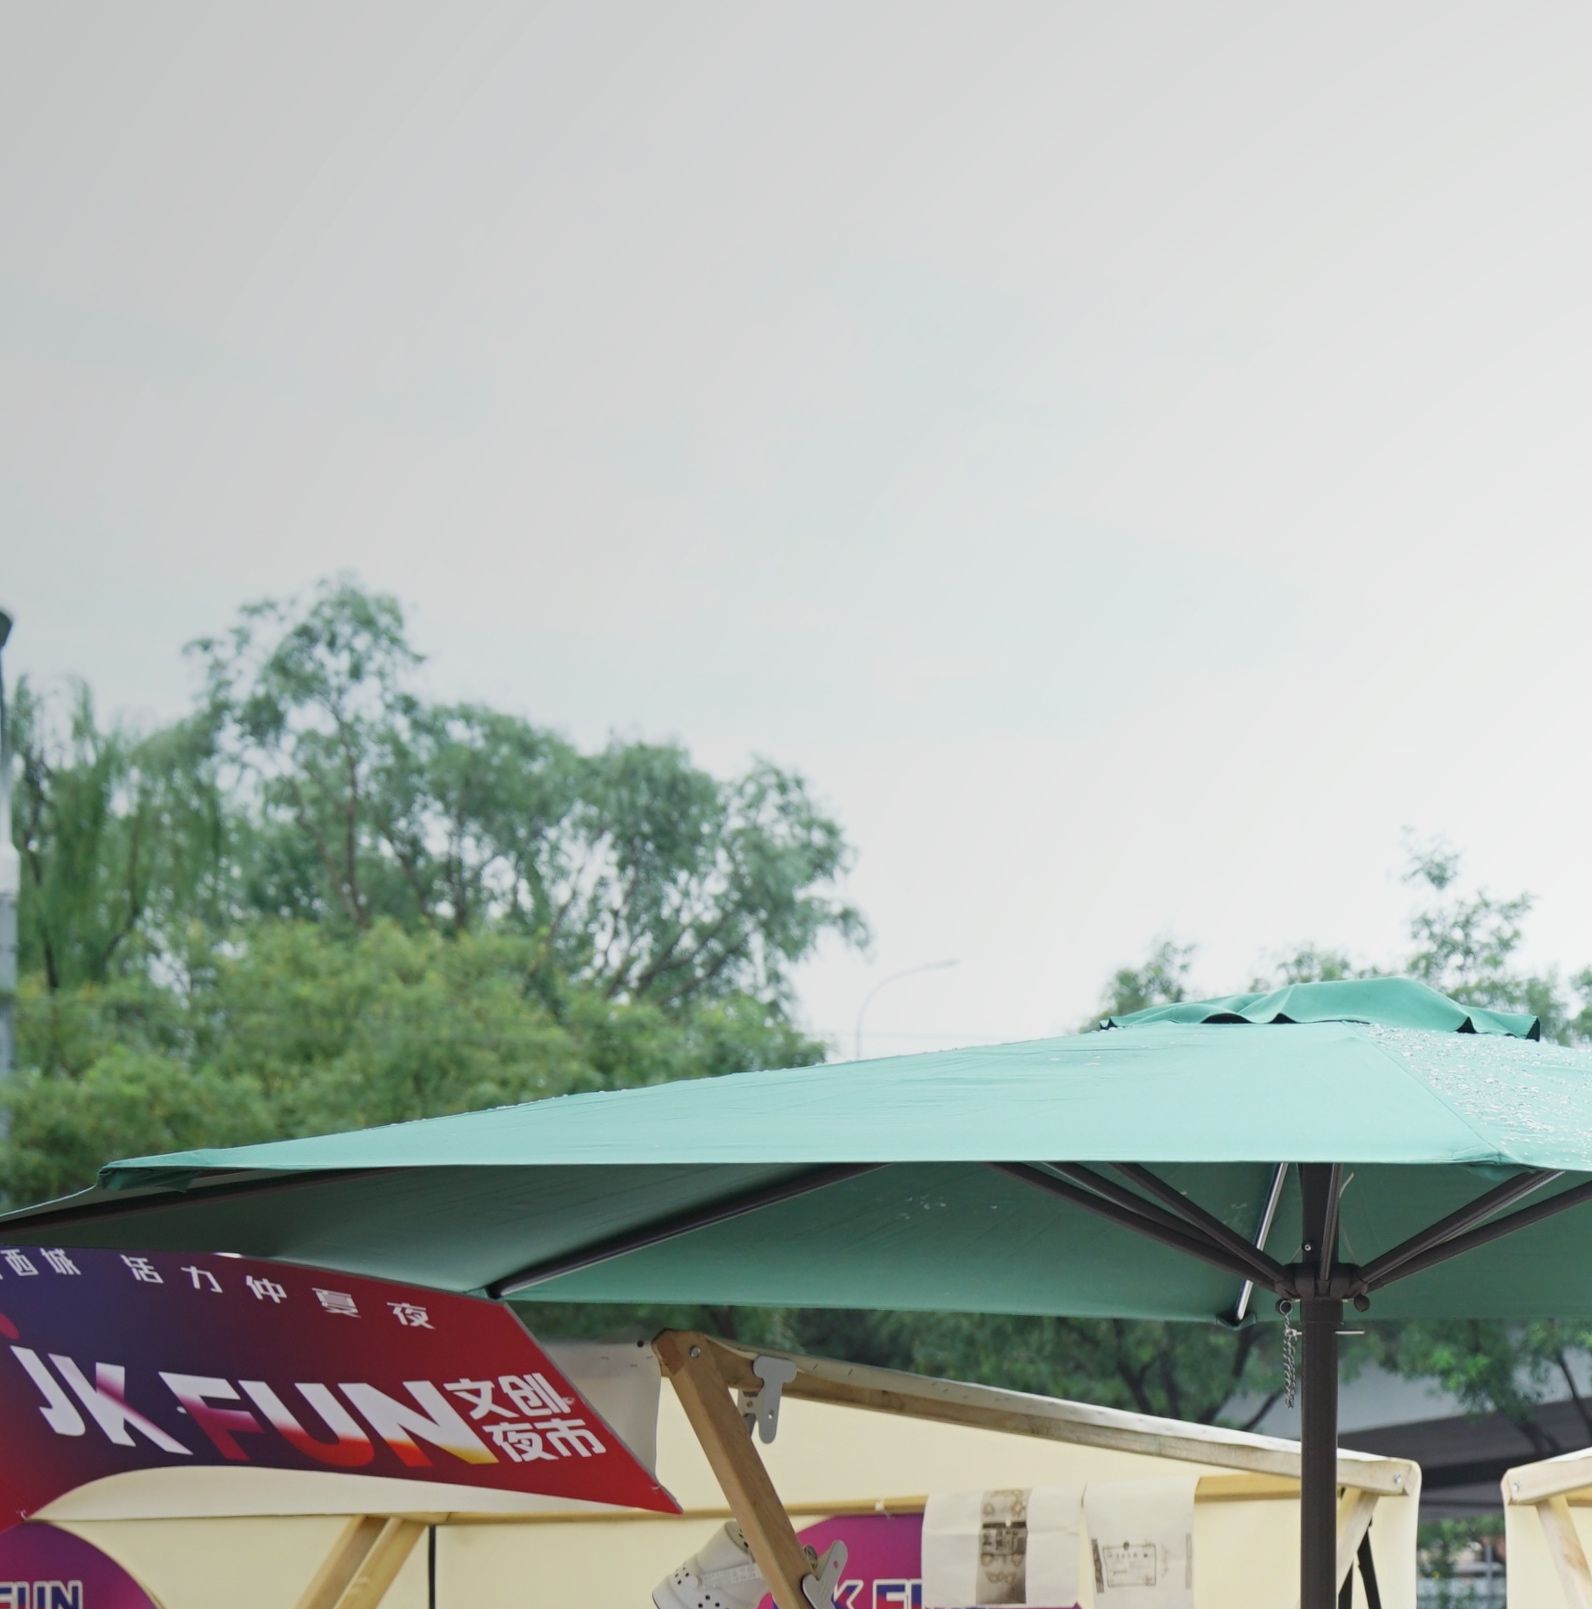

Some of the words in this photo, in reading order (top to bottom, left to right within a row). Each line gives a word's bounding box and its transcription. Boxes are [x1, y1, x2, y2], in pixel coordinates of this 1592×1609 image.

[120, 1254, 436, 1330] 活力仲夏夜
[158, 1370, 500, 1468] FUN
[444, 1373, 558, 1421] 文创
[482, 1416, 606, 1462] 夜市
